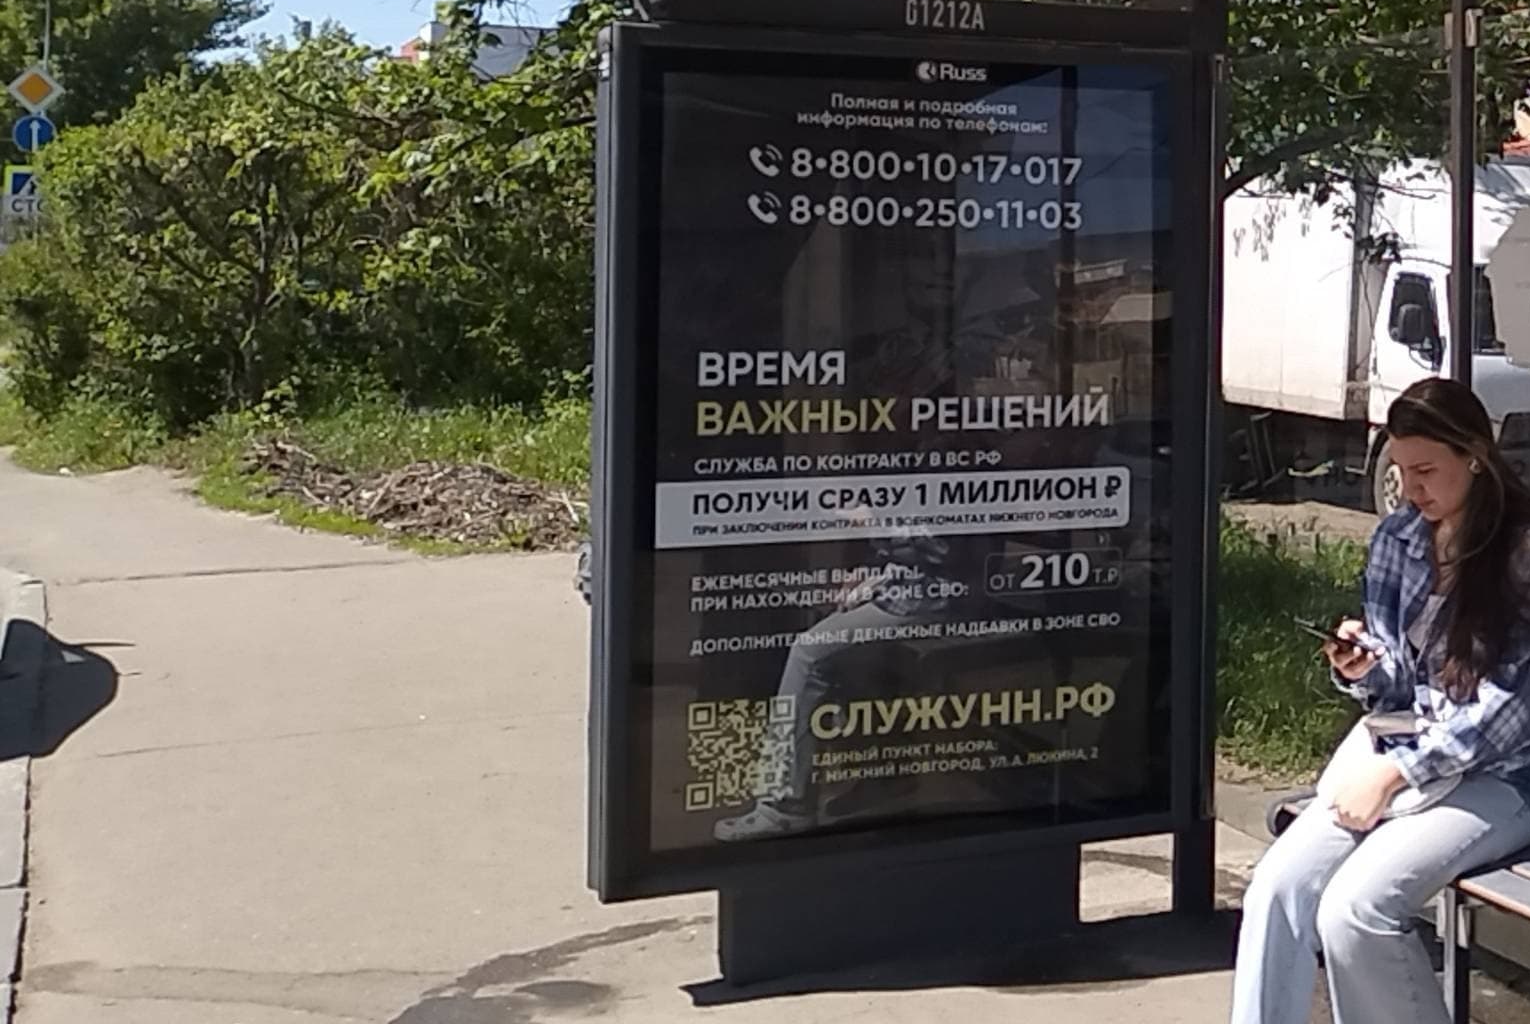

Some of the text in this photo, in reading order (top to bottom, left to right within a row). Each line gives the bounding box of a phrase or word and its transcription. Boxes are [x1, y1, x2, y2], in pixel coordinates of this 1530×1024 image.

[939, 62, 987, 82] Russ
[831, 93, 1018, 116] Полная и подробная
[797, 110, 1048, 135] информация по телефонам:
[697, 350, 847, 388] ВРЕМЯ
[695, 386, 1111, 437] ВАЖНЫХ РЕШЕНИЙ
[694, 450, 1002, 475] СЛУЖБА ПО КОНТРАКТУ В ВС РФ
[692, 489, 808, 516] ПОЛУЧИ
[818, 486, 907, 512] СРАЗУ
[914, 484, 928, 507] 1
[938, 477, 1097, 506] МИЛЛИОН
[692, 507, 1118, 536] ПРИ ЗАКЛЮЧЕНИИ КОНТРАКТА В ВОЕНКОМАТАХ НИЖНЕГО НОВГОРОДА
[691, 570, 827, 593] ЕЖЕМЕСЯЧНЫЕ
[989, 573, 1016, 590] ОТ
[1019, 552, 1091, 590] 210
[690, 582, 970, 612] ПРИ НАХОЖДЕНИИ В ЗОНЕ СВО:
[689, 612, 1121, 658] ДОПОЛНИТЕЛЬНЫЕ ДЕНЕЖНЫЕ НАДБАВКИ В ЗОНЕ СВО
[810, 681, 1117, 740] СЛУЖУНН.РФ
[812, 740, 1000, 767] ЕДИНЫЙ ПУНКТ НАБОРА:
[825, 765, 896, 784] НИЖНИЙ
[899, 758, 986, 775] НОВГОРОД,
[1090, 747, 1099, 760] 2
